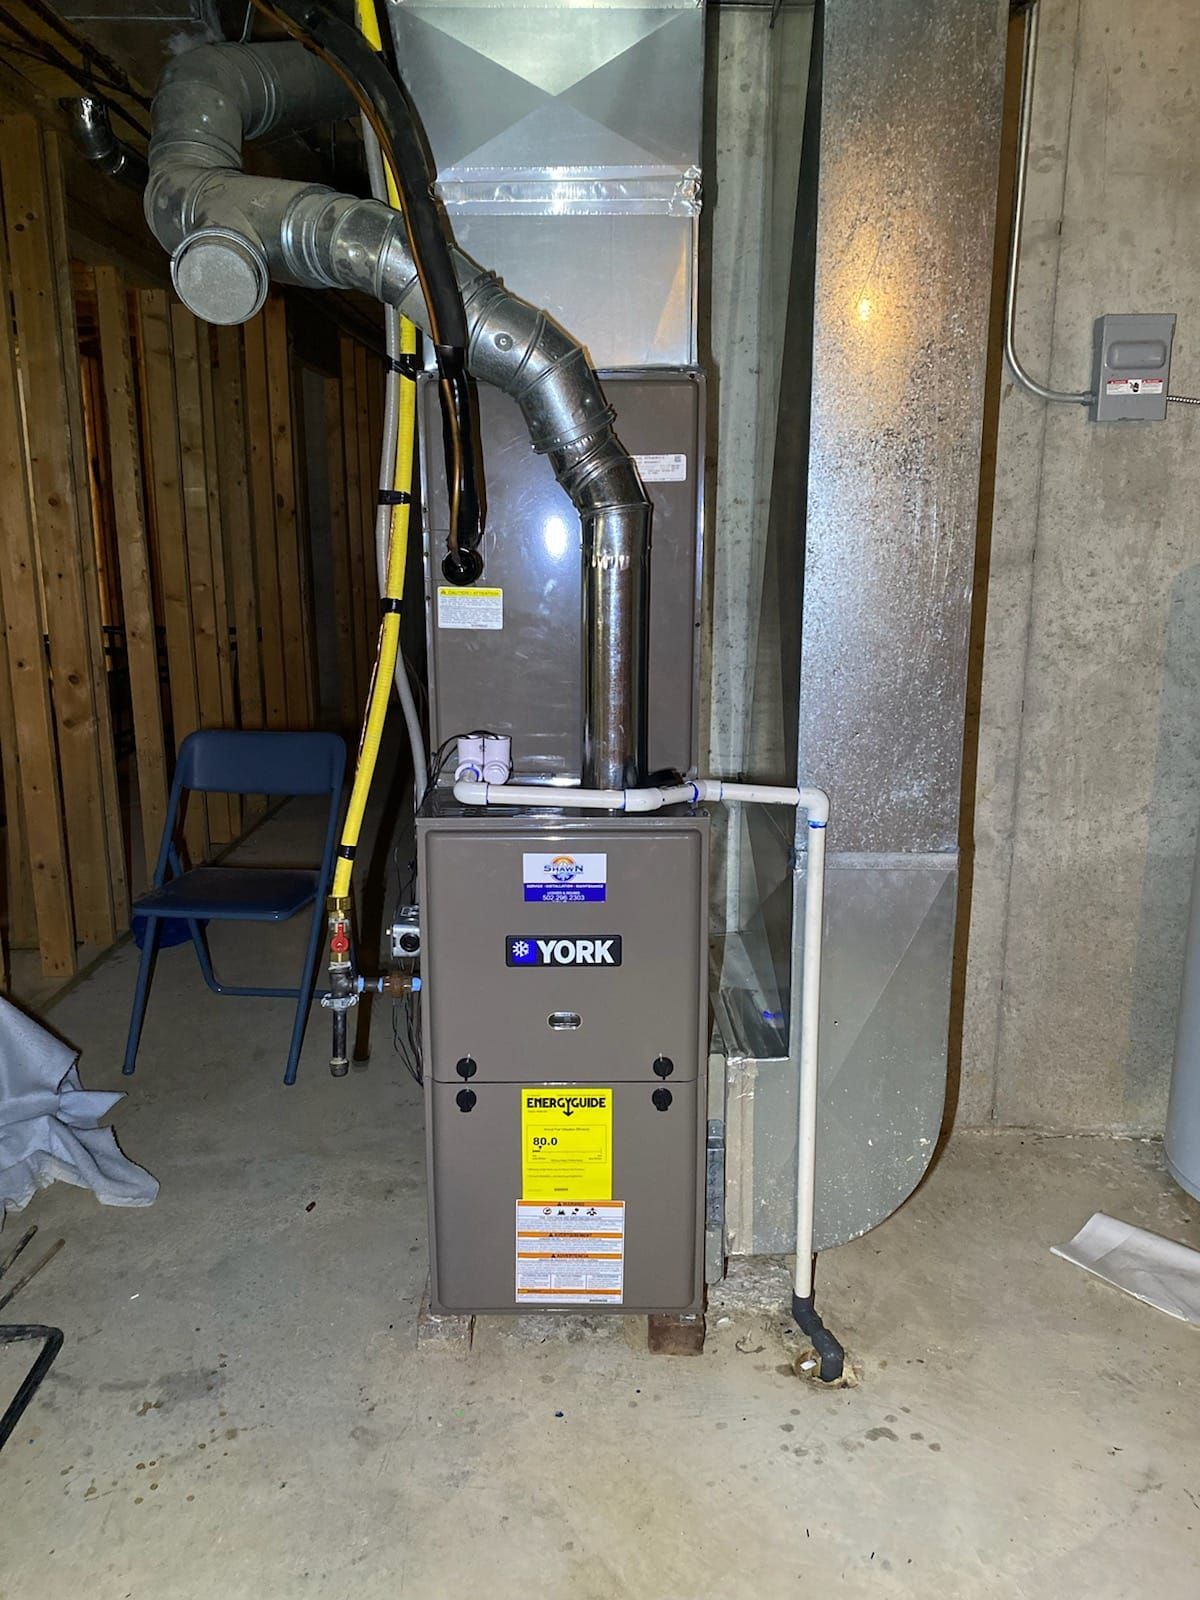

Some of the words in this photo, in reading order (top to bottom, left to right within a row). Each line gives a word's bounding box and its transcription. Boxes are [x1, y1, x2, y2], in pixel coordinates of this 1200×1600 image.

[543, 865, 584, 873] SHAWN
[536, 939, 615, 964] YORK
[526, 1097, 606, 1109] ENERGYGUIDE
[532, 1137, 558, 1146] 80.0
